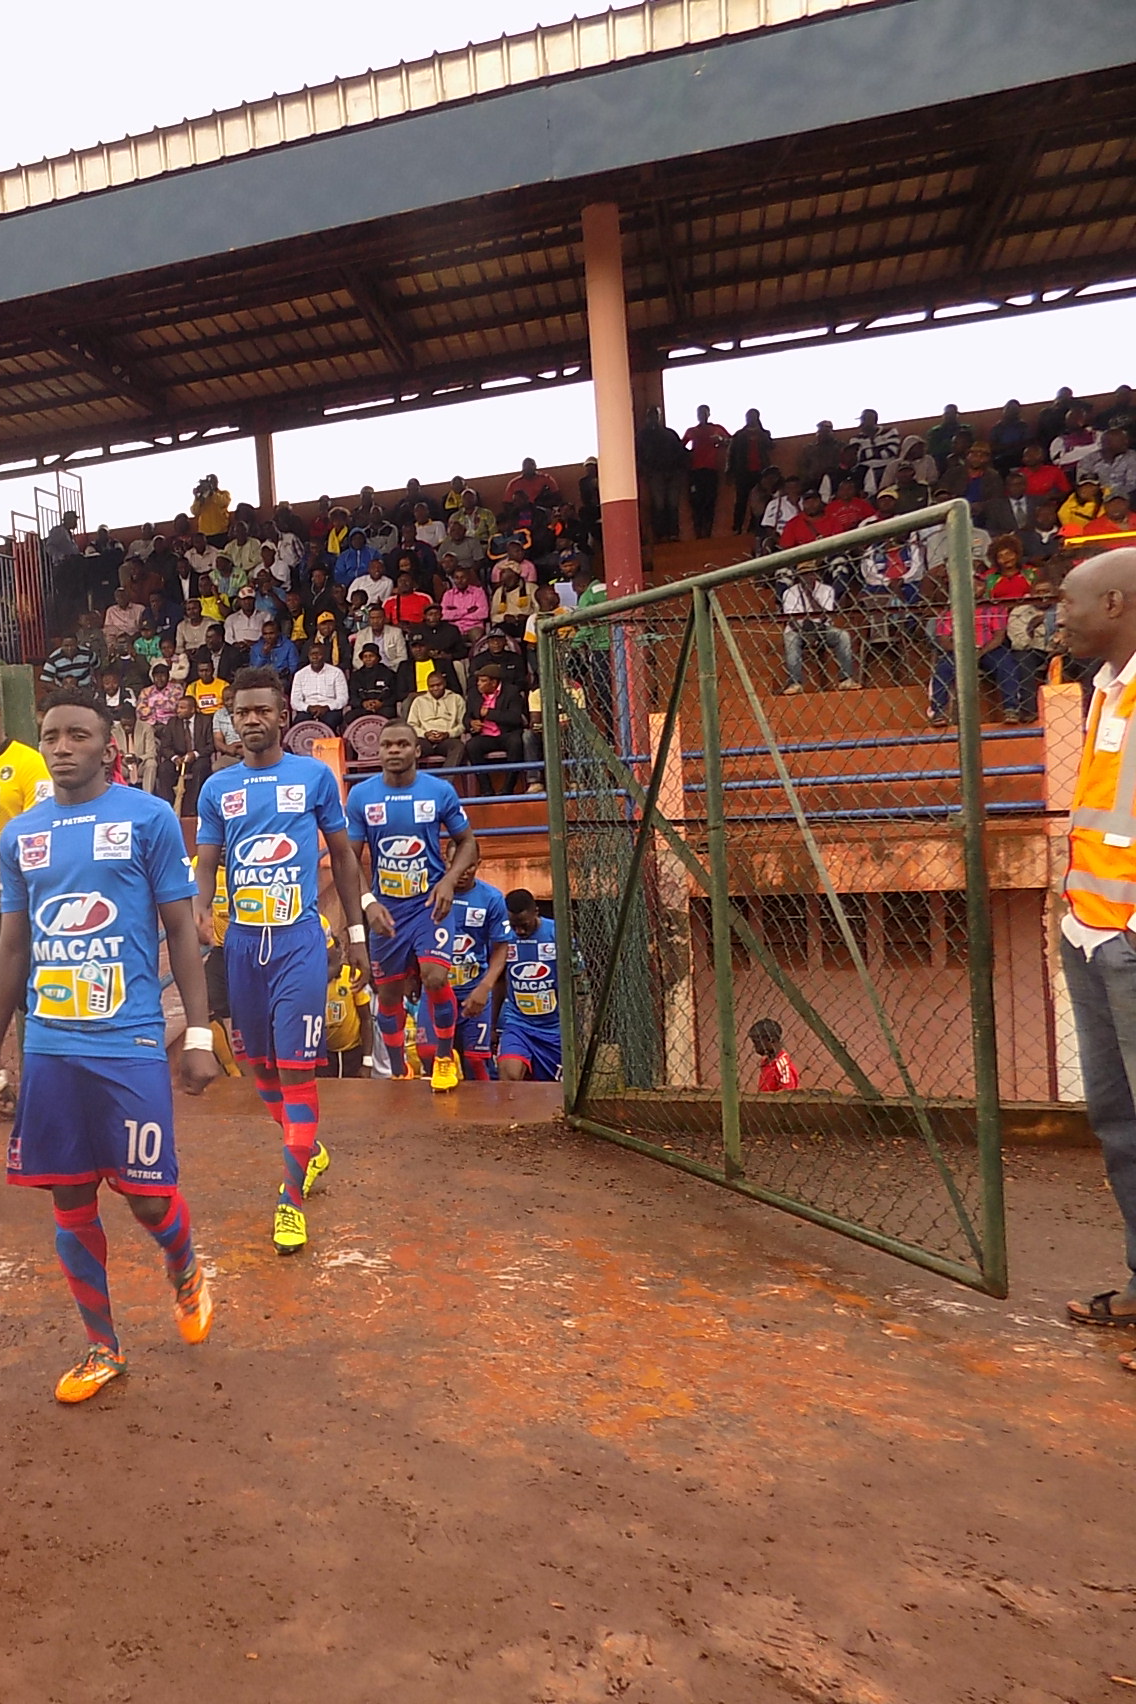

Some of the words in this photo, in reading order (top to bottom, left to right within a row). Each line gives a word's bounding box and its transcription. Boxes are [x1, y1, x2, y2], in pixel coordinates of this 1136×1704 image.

[62, 814, 97, 826] PATRICK
[377, 856, 428, 871] MACAT
[233, 866, 301, 886] MACAT
[32, 936, 124, 962] MACAT
[434, 927, 449, 949] 9
[302, 1014, 323, 1048] 18
[477, 1023, 488, 1045] 7
[124, 1119, 162, 1167] 10
[127, 1168, 163, 1180] PATRICK
